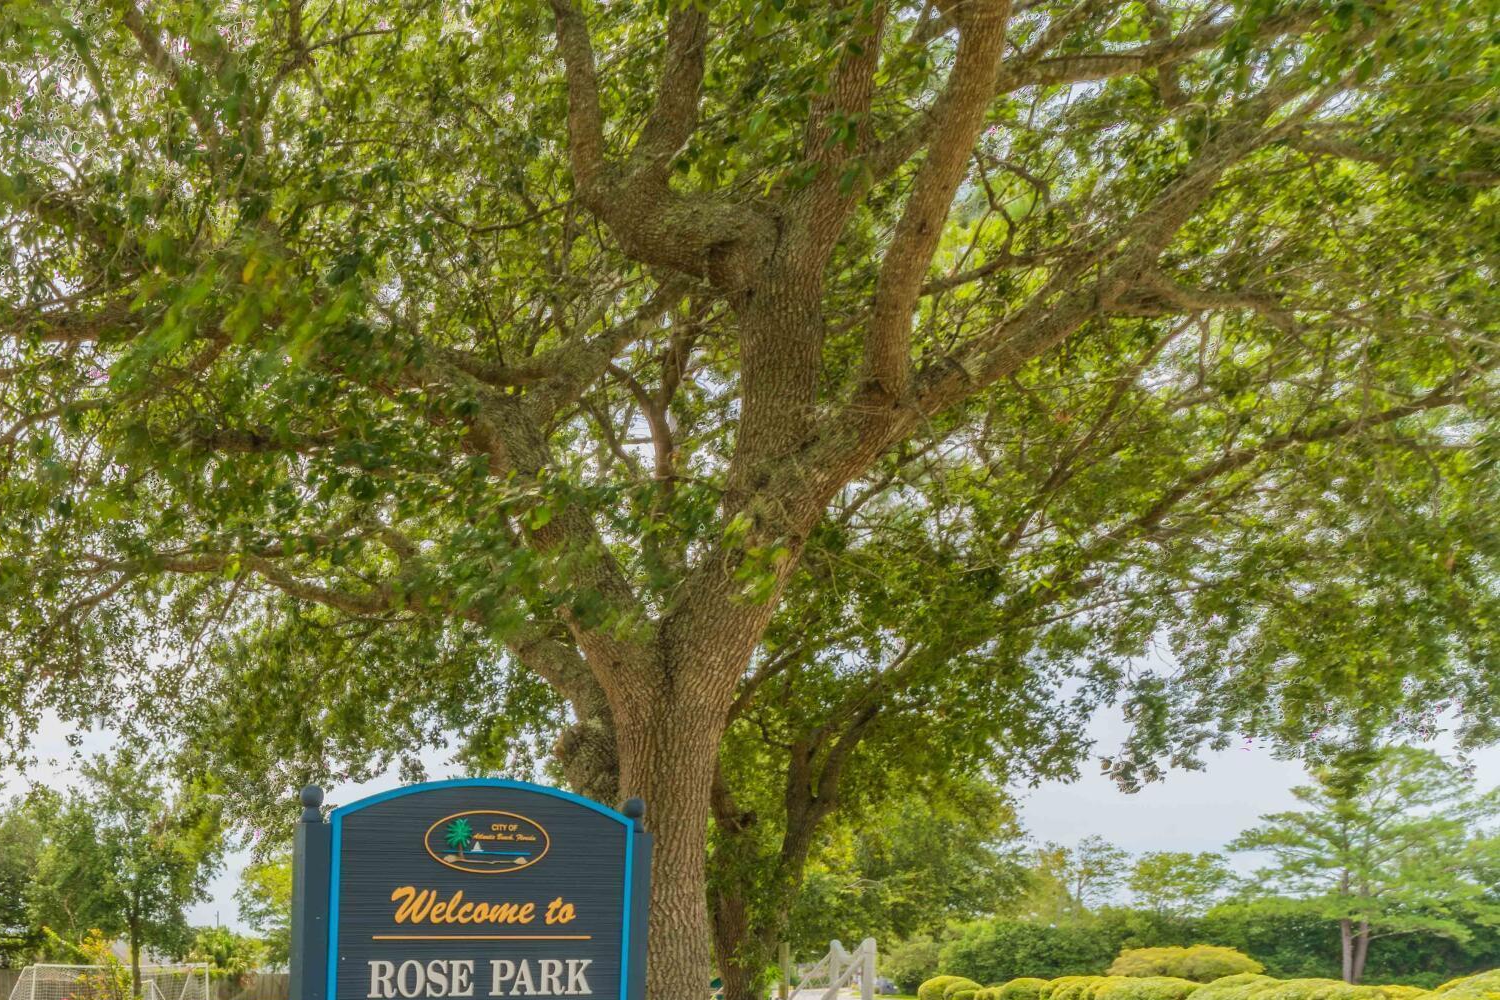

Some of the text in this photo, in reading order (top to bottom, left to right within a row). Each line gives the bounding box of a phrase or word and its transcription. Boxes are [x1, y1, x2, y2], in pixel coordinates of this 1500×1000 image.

[491, 824, 518, 832] CITY OF
[391, 886, 576, 925] Welcome to
[367, 958, 593, 999] ROSE PARK
